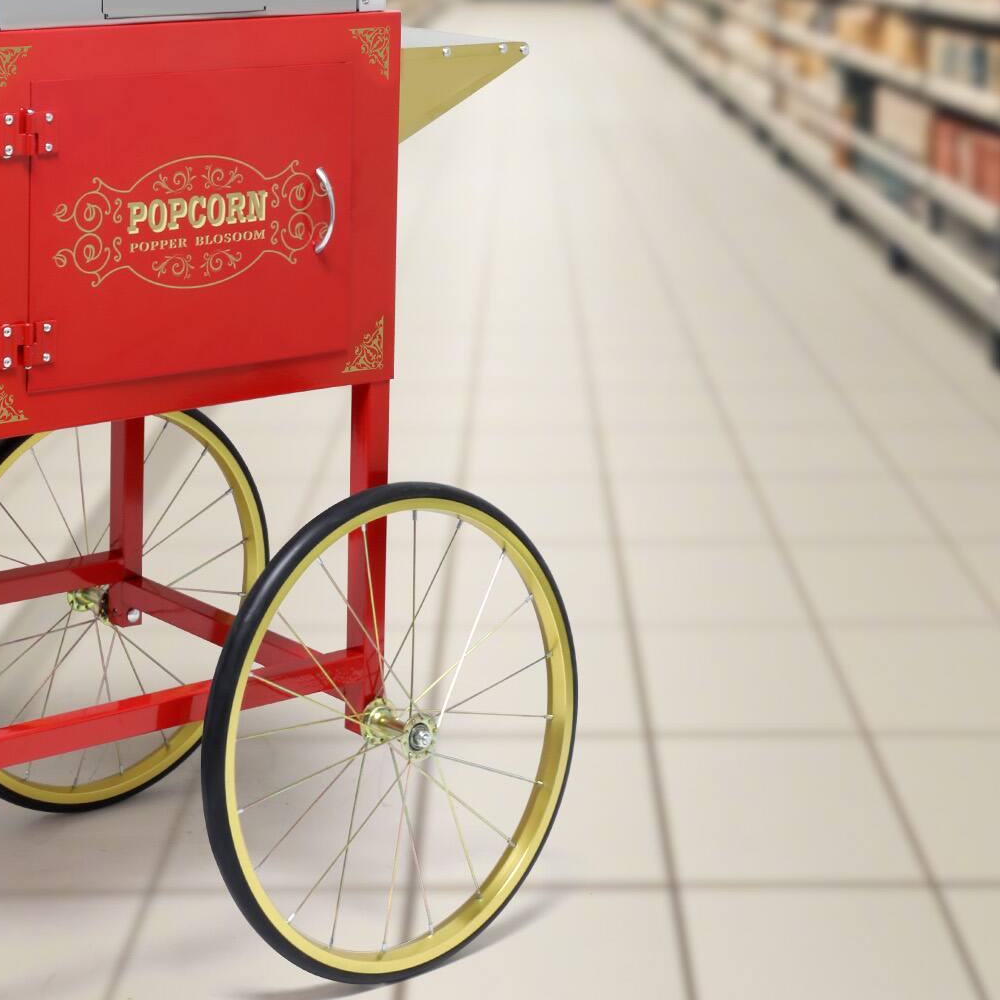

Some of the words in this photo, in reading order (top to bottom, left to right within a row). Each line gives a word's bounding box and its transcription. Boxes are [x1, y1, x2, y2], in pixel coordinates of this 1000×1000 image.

[127, 190, 268, 235] POPCORN
[129, 238, 187, 253] POPPER
[195, 229, 266, 247] BLOSOOM
